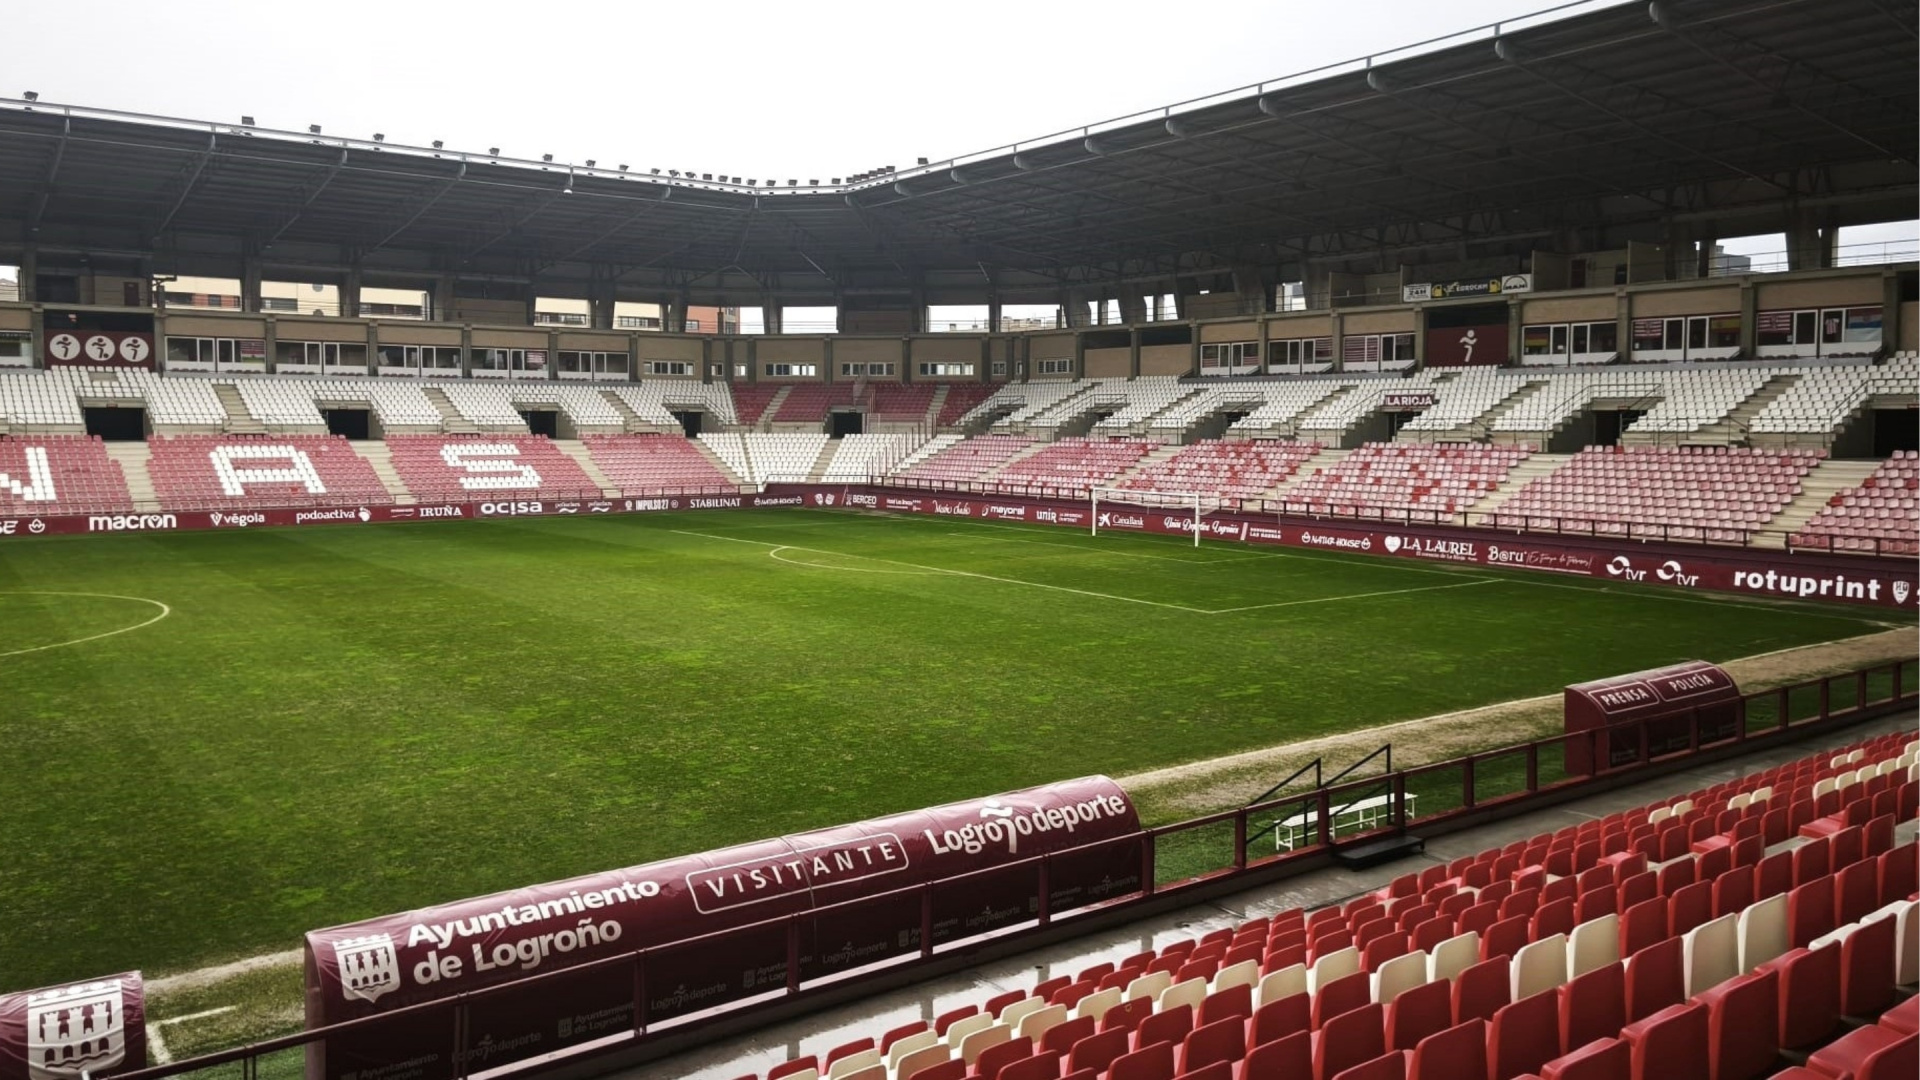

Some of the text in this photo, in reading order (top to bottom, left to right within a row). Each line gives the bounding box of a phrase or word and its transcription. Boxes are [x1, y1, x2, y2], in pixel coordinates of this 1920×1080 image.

[1387, 396, 1433, 406] LA RIOJA
[690, 498, 741, 508] STABILINAT
[852, 494, 877, 505] BERCEO
[295, 510, 356, 524] podoactiva
[419, 504, 463, 517] IRUÑA
[990, 506, 1025, 516] mayoral
[89, 514, 177, 531] macron
[1402, 537, 1477, 556] LA LAUREL
[1625, 568, 1647, 581] tvr
[1676, 571, 1699, 587] tvr
[1734, 569, 1881, 600] rotuprint
[1668, 674, 1715, 692] POLICÍA
[1600, 687, 1650, 706] PRENSA
[706, 841, 897, 899] VISITANTE
[407, 879, 660, 952] Ayuntamiento
[413, 918, 623, 985] de Logroño
